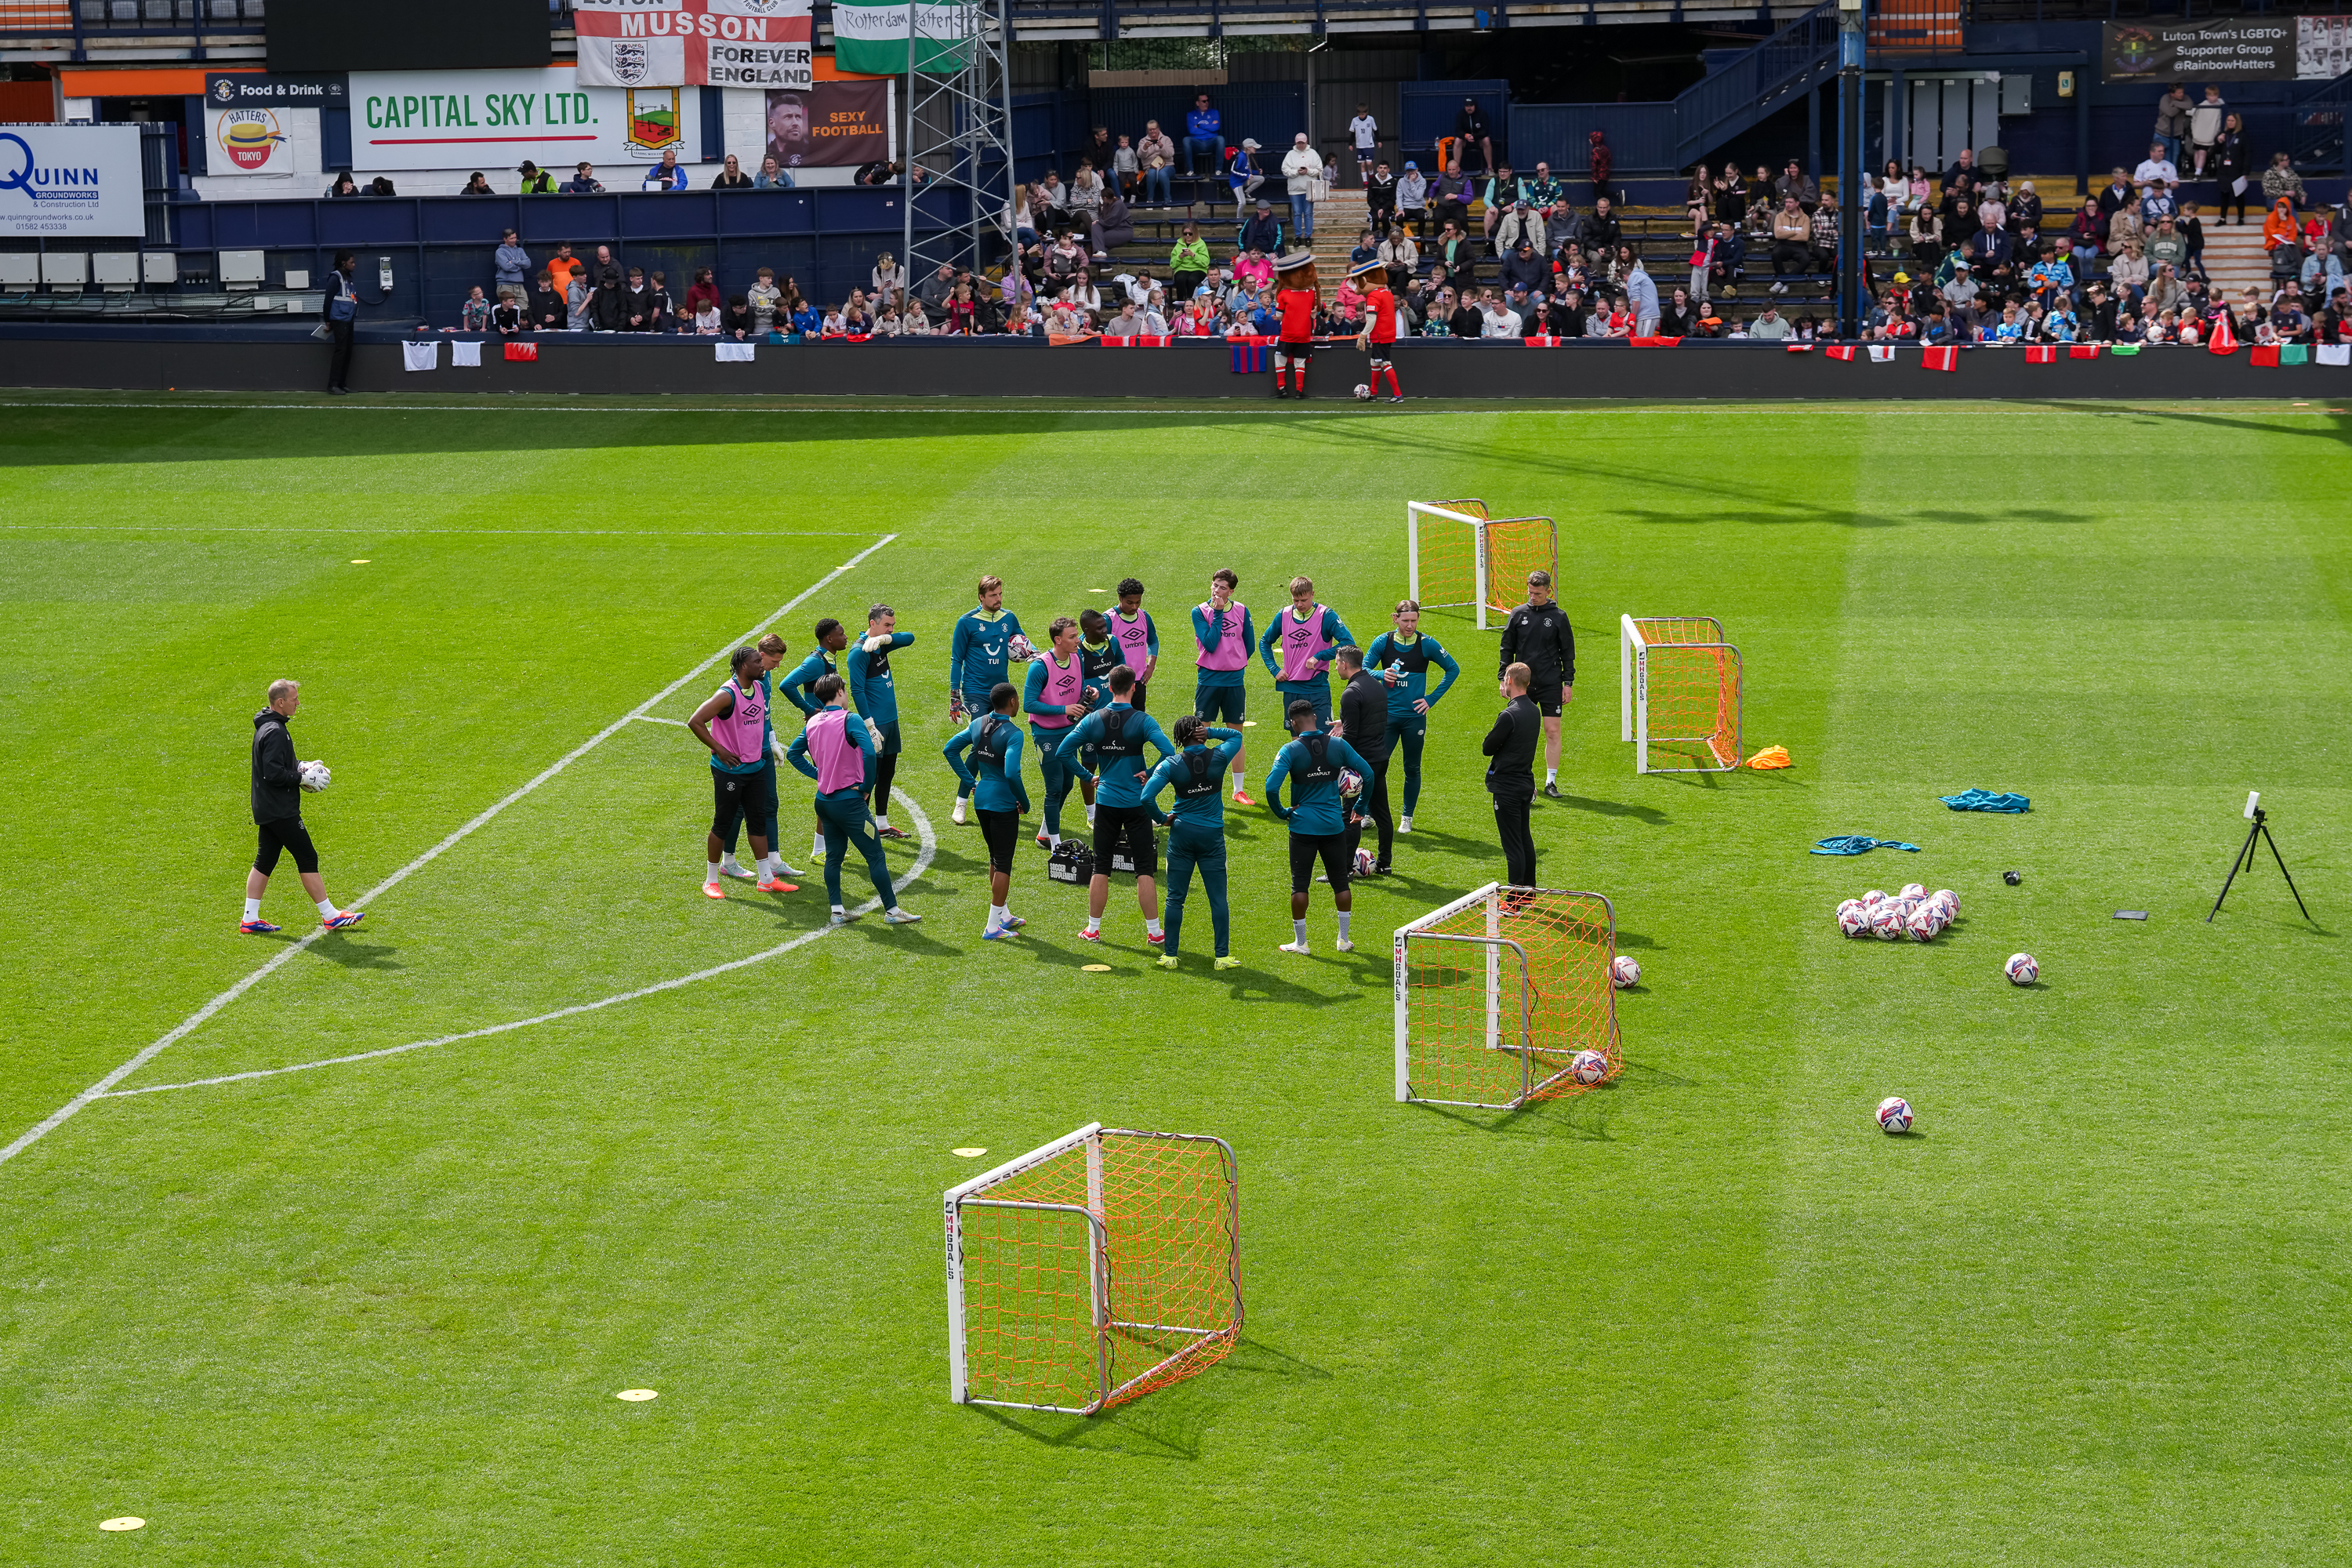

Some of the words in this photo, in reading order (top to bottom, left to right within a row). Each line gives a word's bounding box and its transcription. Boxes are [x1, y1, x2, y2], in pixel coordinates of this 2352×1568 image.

[766, 0, 779, 12] CLUB
[844, 9, 908, 31] Rotterdam
[620, 12, 767, 41] MUSSON
[2162, 31, 2195, 42] Luton
[2198, 30, 2238, 40] Town's
[2240, 28, 2288, 39] LGBTQ+
[712, 45, 811, 64] FOREVER
[2176, 45, 2234, 57] Supporter
[2237, 44, 2274, 56] Group
[2172, 60, 2276, 71] @RainbowHatters
[710, 67, 811, 84] ENGLAND
[240, 85, 273, 96] Food
[276, 85, 286, 96] &
[289, 84, 324, 96] Drink
[228, 110, 267, 124] HATTERS
[366, 94, 477, 129] CAPITAL
[485, 93, 535, 126] SKY
[545, 93, 598, 125] LTD.
[829, 111, 866, 123] SEXY
[812, 123, 883, 137] FOOTBALL
[0, 132, 98, 190] QUINN
[238, 151, 261, 162] TOKYO
[666, 297, 673, 316] 4
[1124, 641, 1145, 649] umbro
[1093, 661, 1112, 670] CATAPULT
[978, 750, 995, 758] CATAPULT
[1187, 785, 1213, 794] CATAPULT
[1049, 862, 1066, 872] SOCCER
[1050, 870, 1077, 882] SUPPLEMENT
